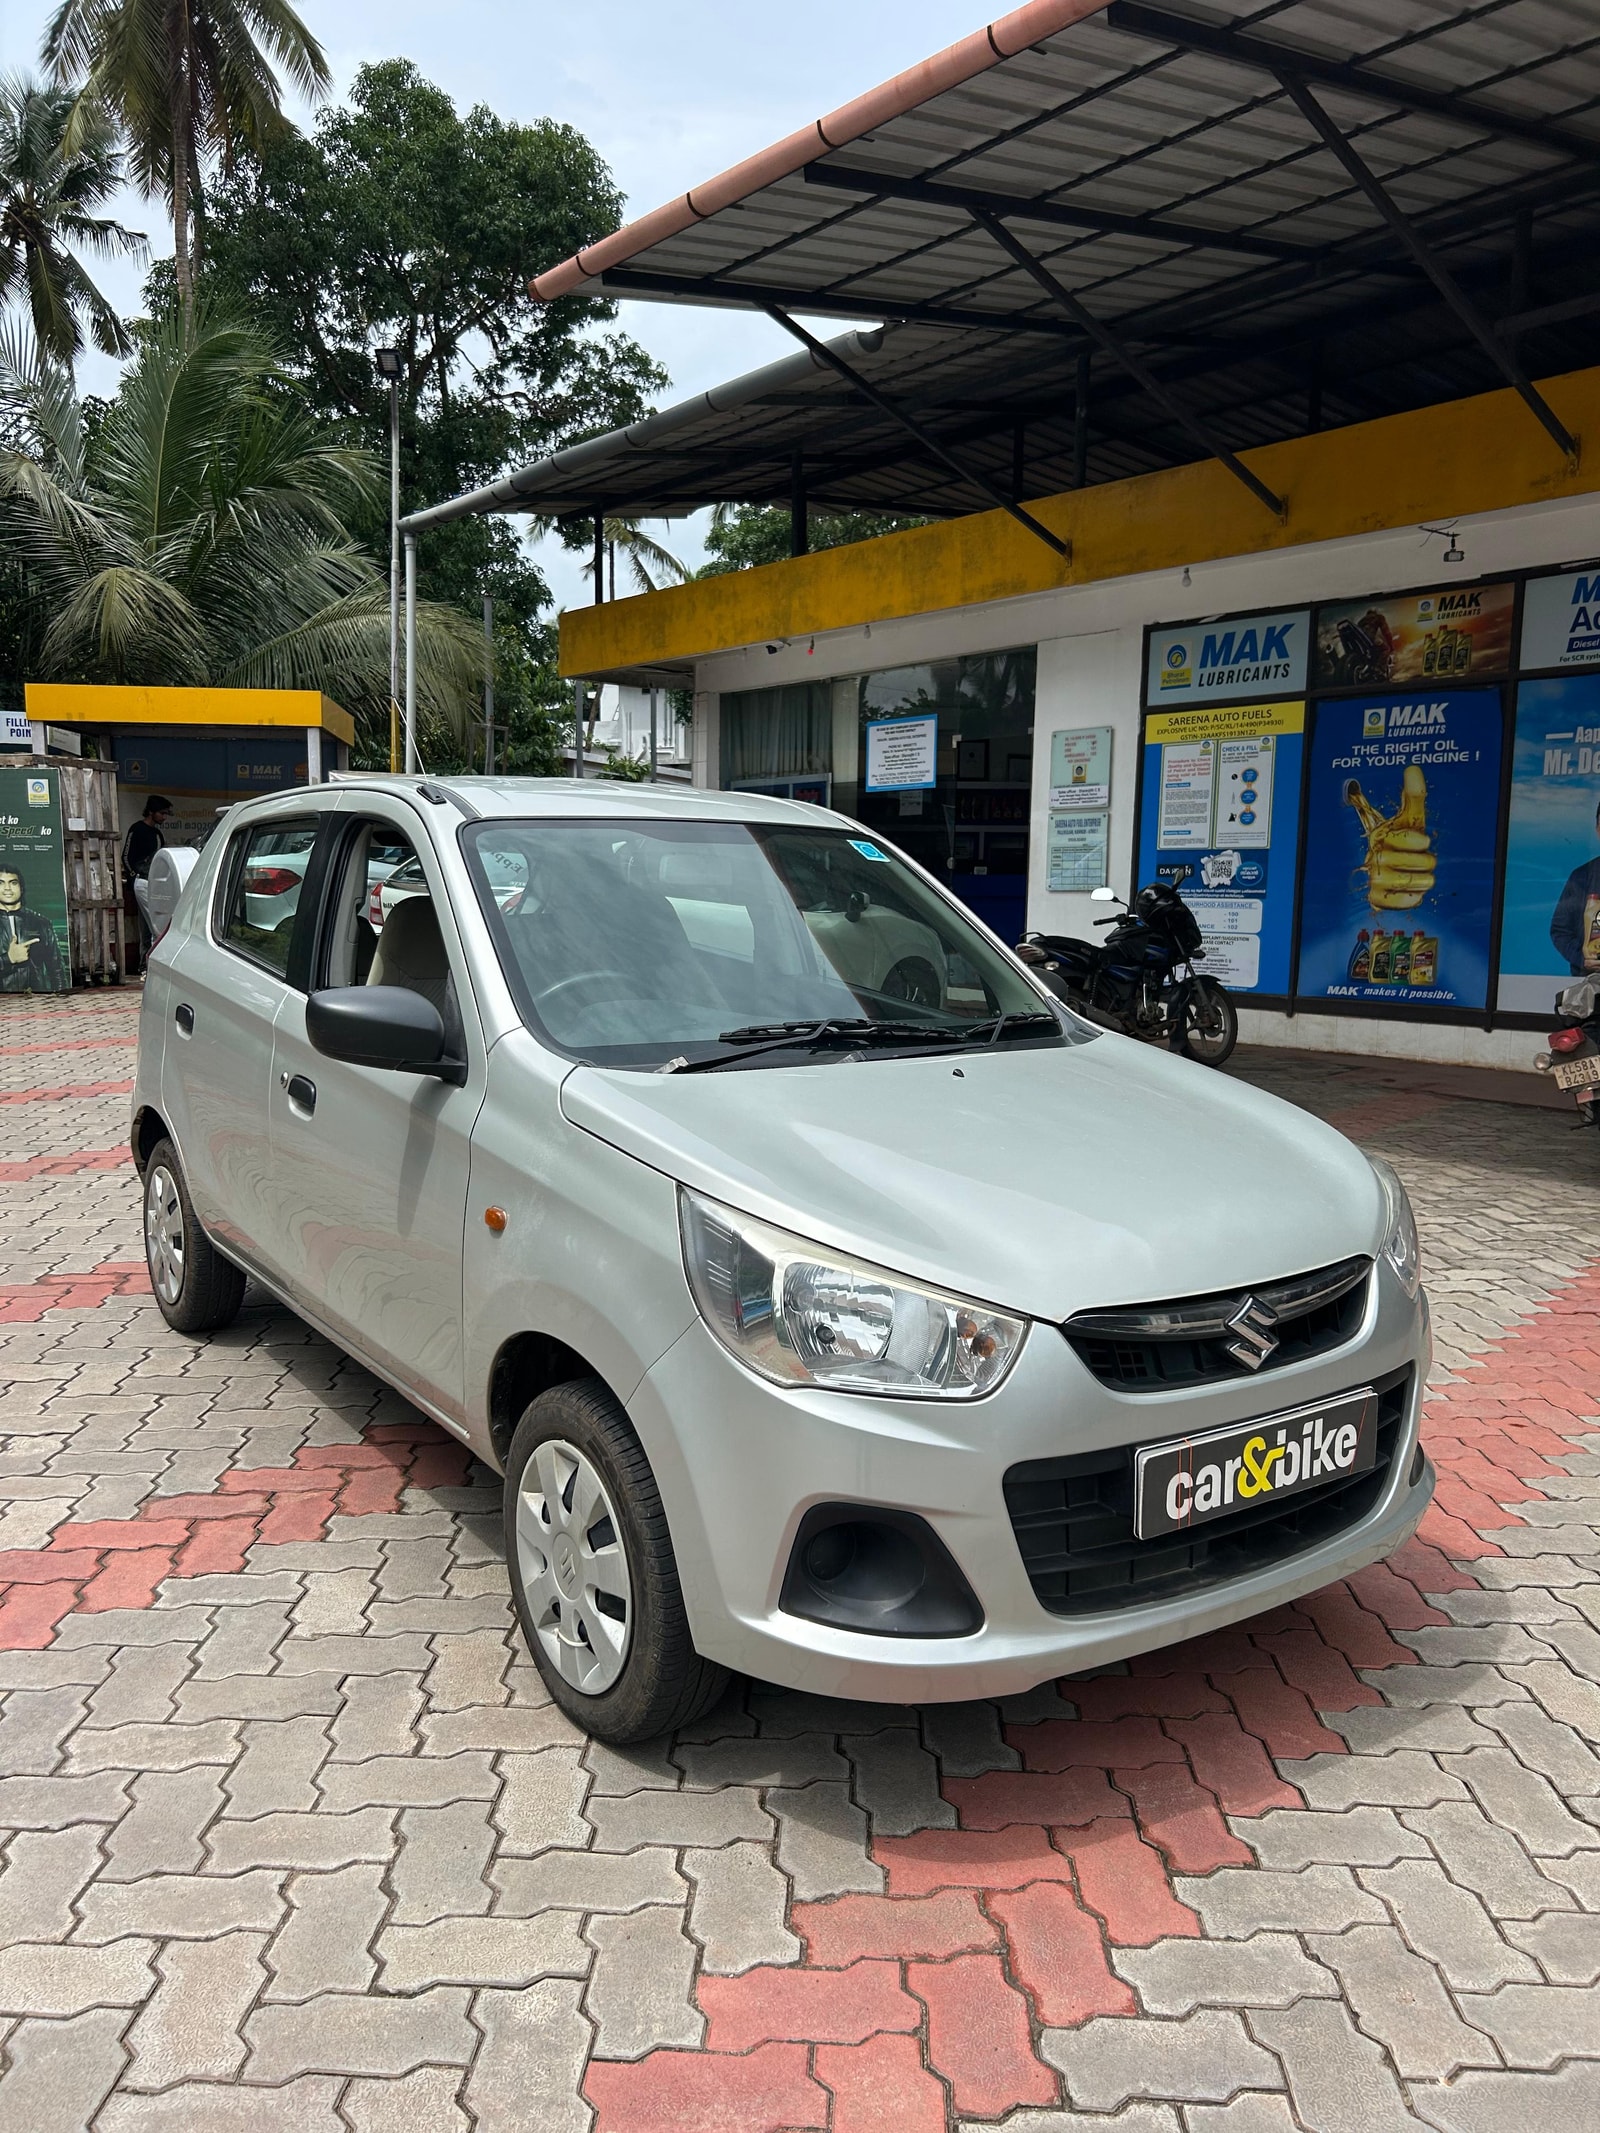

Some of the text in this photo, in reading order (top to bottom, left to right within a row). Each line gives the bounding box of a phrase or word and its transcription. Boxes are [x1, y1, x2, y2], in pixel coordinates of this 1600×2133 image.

[1438, 592, 1483, 613] MAK
[1436, 608, 1481, 620] LUBRICANTS
[1199, 623, 1296, 669] MAK
[1198, 663, 1290, 687] LUBRICANTS
[1168, 709, 1272, 727] SAREENA AUTO FUELS
[1388, 702, 1449, 727] MAK
[1388, 724, 1446, 738] LUBRICANTS
[1352, 739, 1459, 756] THE RIGHT OIL
[1332, 757, 1361, 768] FOR
[1366, 754, 1406, 767] YOUR
[1411, 751, 1470, 765] ENGINE
[1543, 748, 1573, 776] Mr.
[252, 765, 282, 775] MAK
[40, 825, 52, 836] ko
[1327, 985, 1457, 1000] MAK makes it possible.
[1561, 1059, 1596, 1076] KL58A
[1165, 1417, 1358, 1520] car&bike
